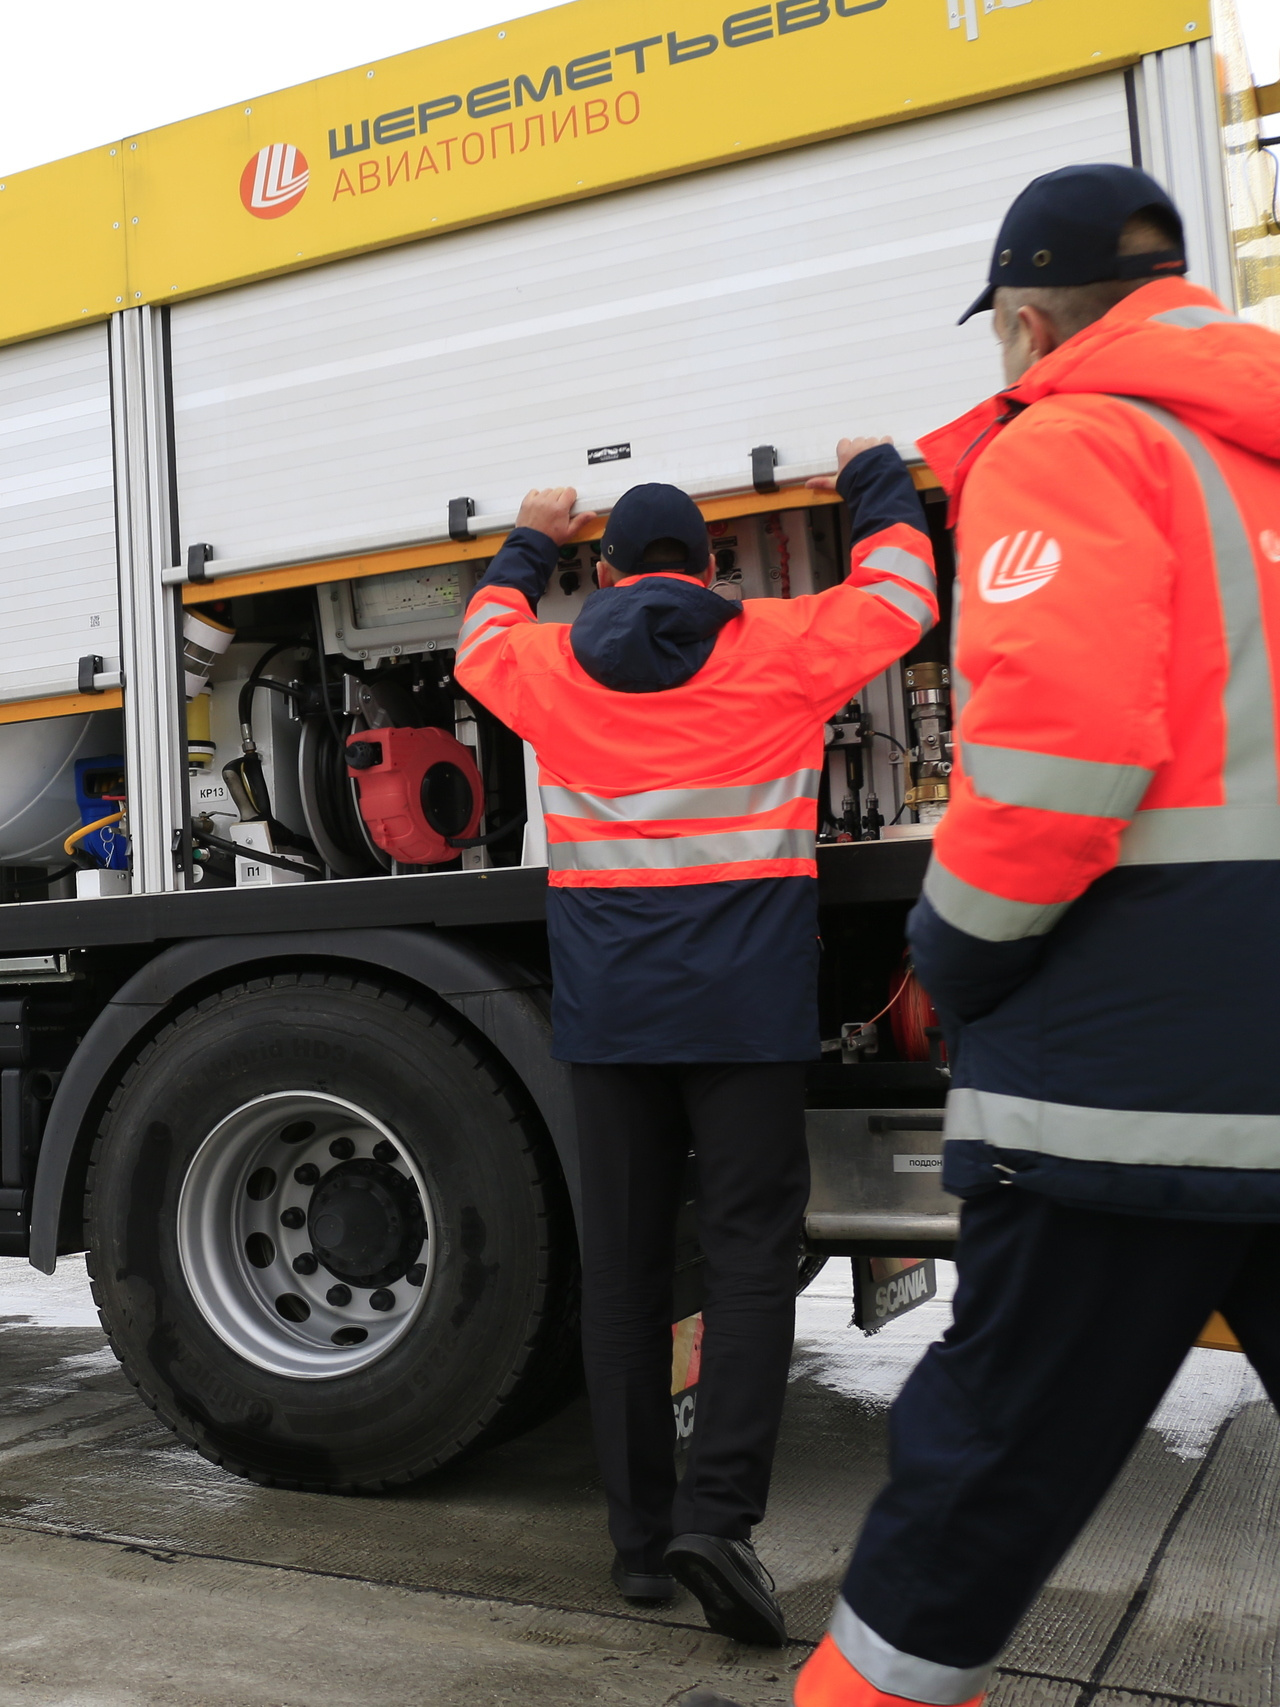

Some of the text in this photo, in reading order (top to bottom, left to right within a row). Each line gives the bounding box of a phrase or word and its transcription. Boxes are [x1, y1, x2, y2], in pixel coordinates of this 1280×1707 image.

[332, 90, 642, 202] АВИАТОПЛИВО
[247, 866, 260, 877] П1
[875, 1266, 929, 1317] SCANIA
